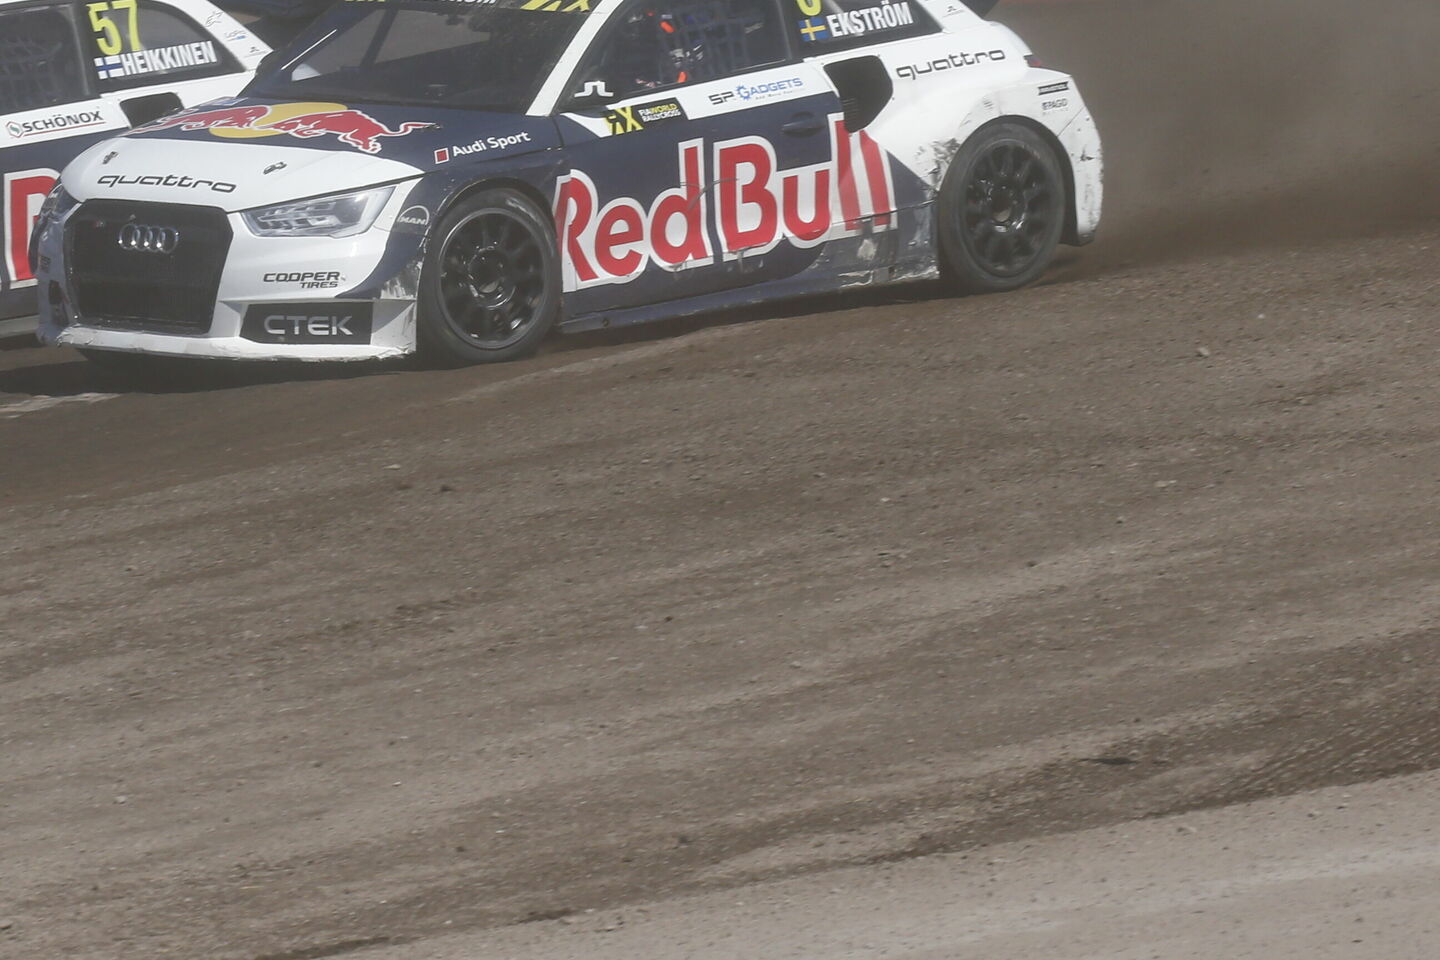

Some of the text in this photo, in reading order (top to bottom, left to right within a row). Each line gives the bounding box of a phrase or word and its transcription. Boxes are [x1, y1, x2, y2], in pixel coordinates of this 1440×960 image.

[826, 0, 913, 38] EKSTRÖM
[120, 41, 217, 76] HEIKKINEN
[896, 49, 1006, 81] quattro
[708, 91, 735, 105] SP
[736, 77, 804, 100] GADGETS
[22, 110, 103, 132] SCHÖNOX
[453, 132, 531, 157] Audi Sport
[97, 174, 237, 193] quattro
[554, 118, 893, 283] Red Bull
[263, 272, 340, 282] COOPER
[300, 281, 338, 289] TIRES
[264, 315, 353, 336] CTEK
